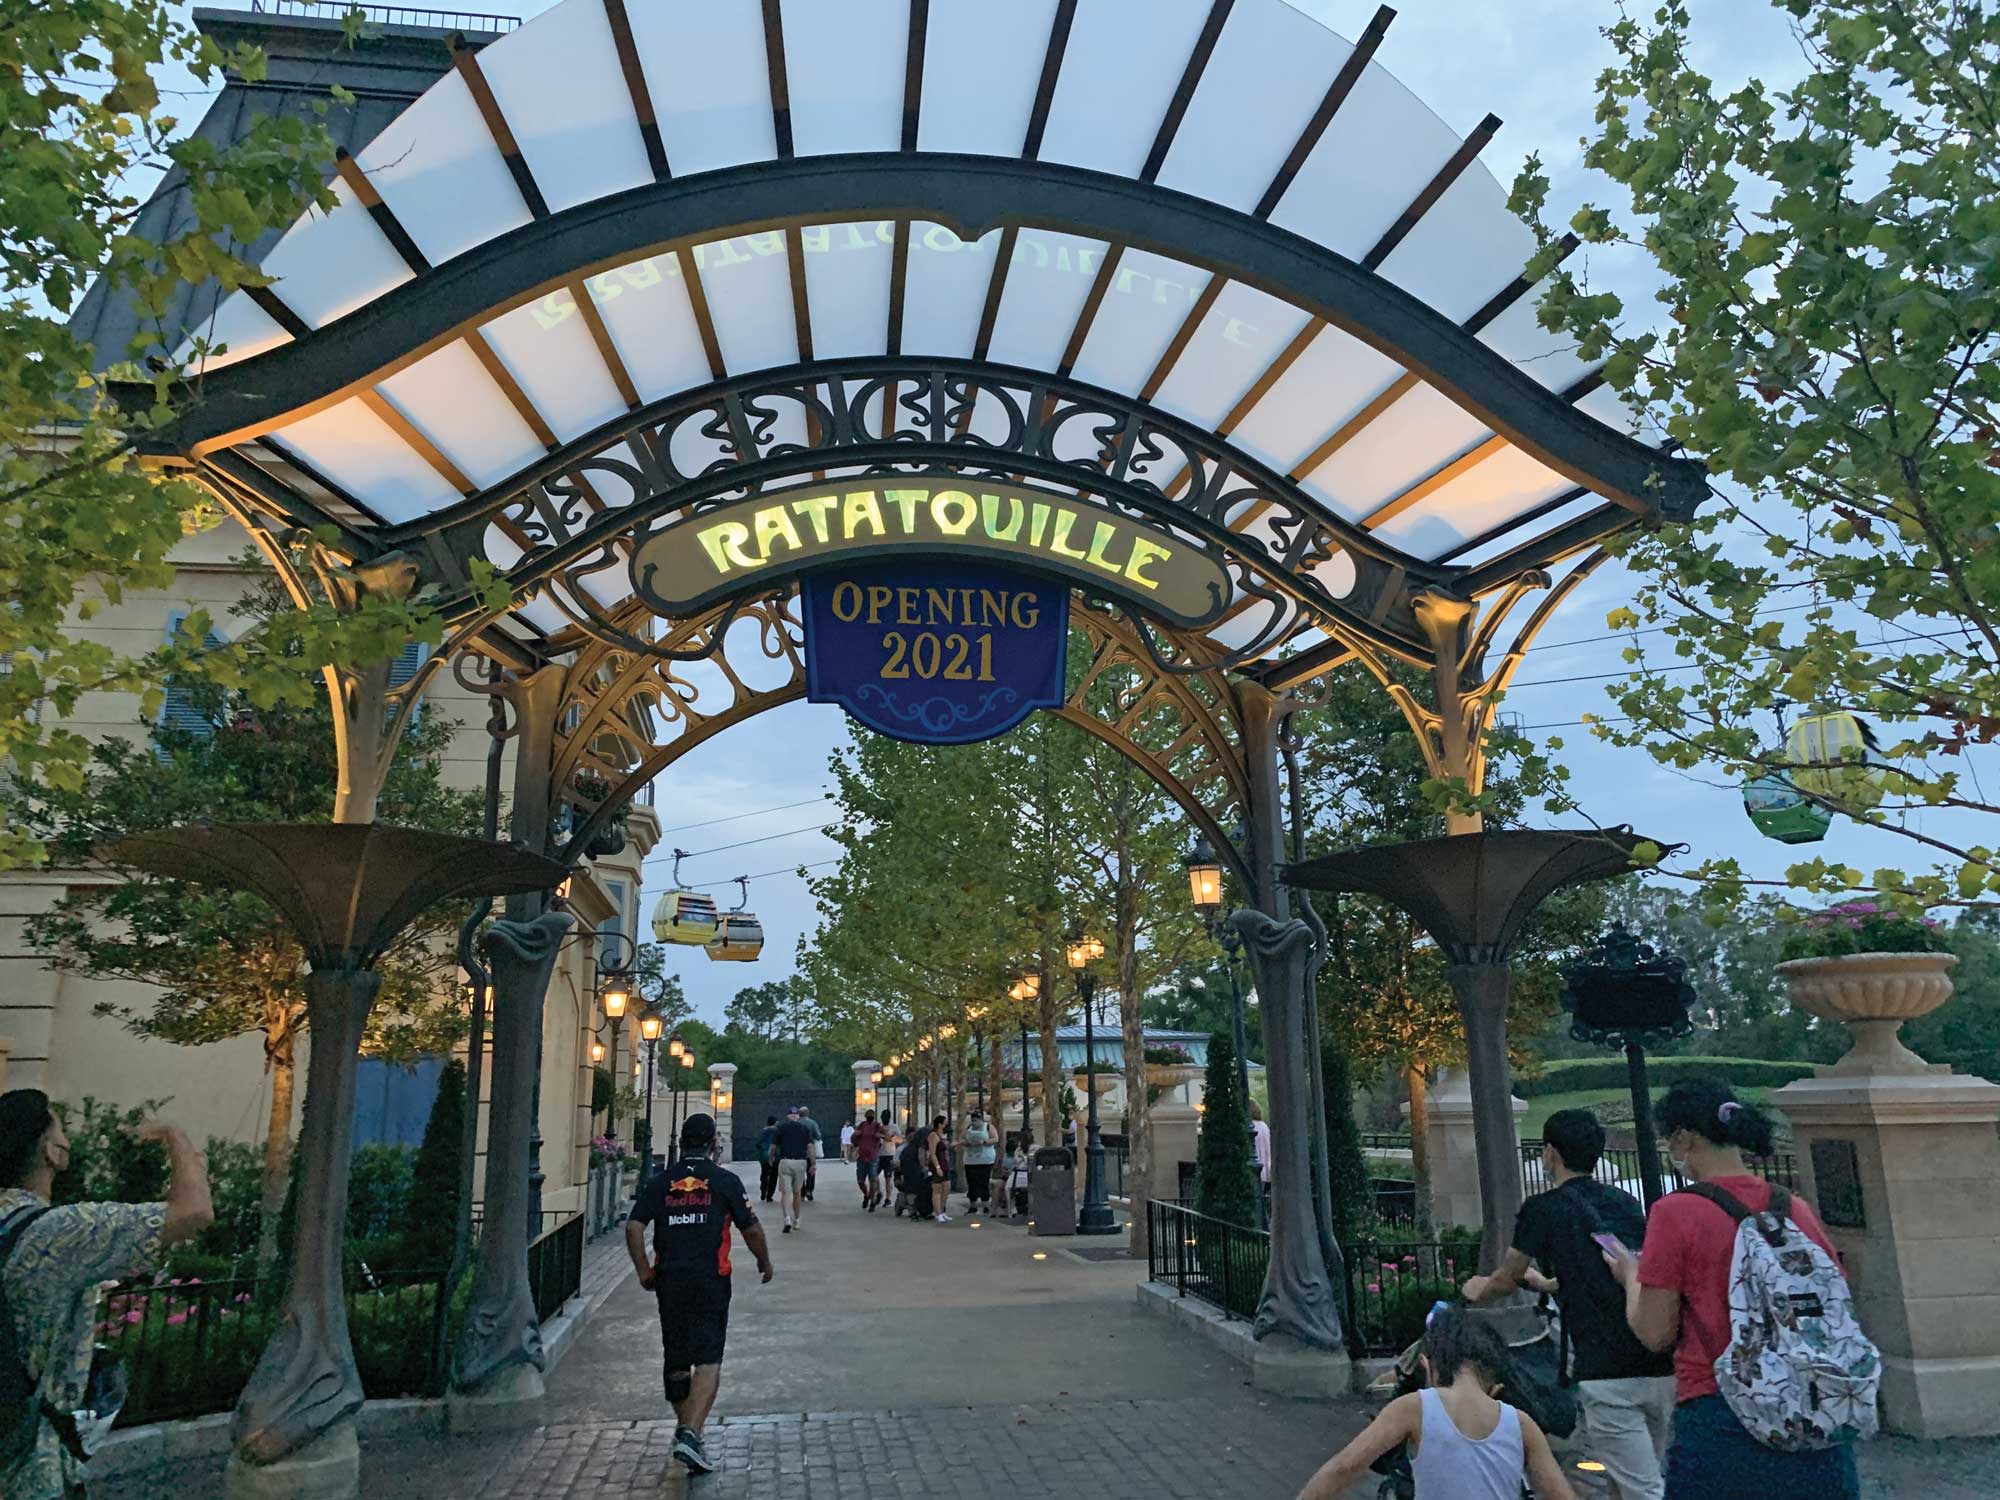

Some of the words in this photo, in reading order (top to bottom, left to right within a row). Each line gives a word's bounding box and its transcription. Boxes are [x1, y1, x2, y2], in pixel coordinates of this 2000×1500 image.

[697, 489, 1173, 590] RATATOUILLE
[831, 580, 1040, 630] OPENING
[880, 631, 996, 681] 2021
[668, 1213, 695, 1226] Mobil
